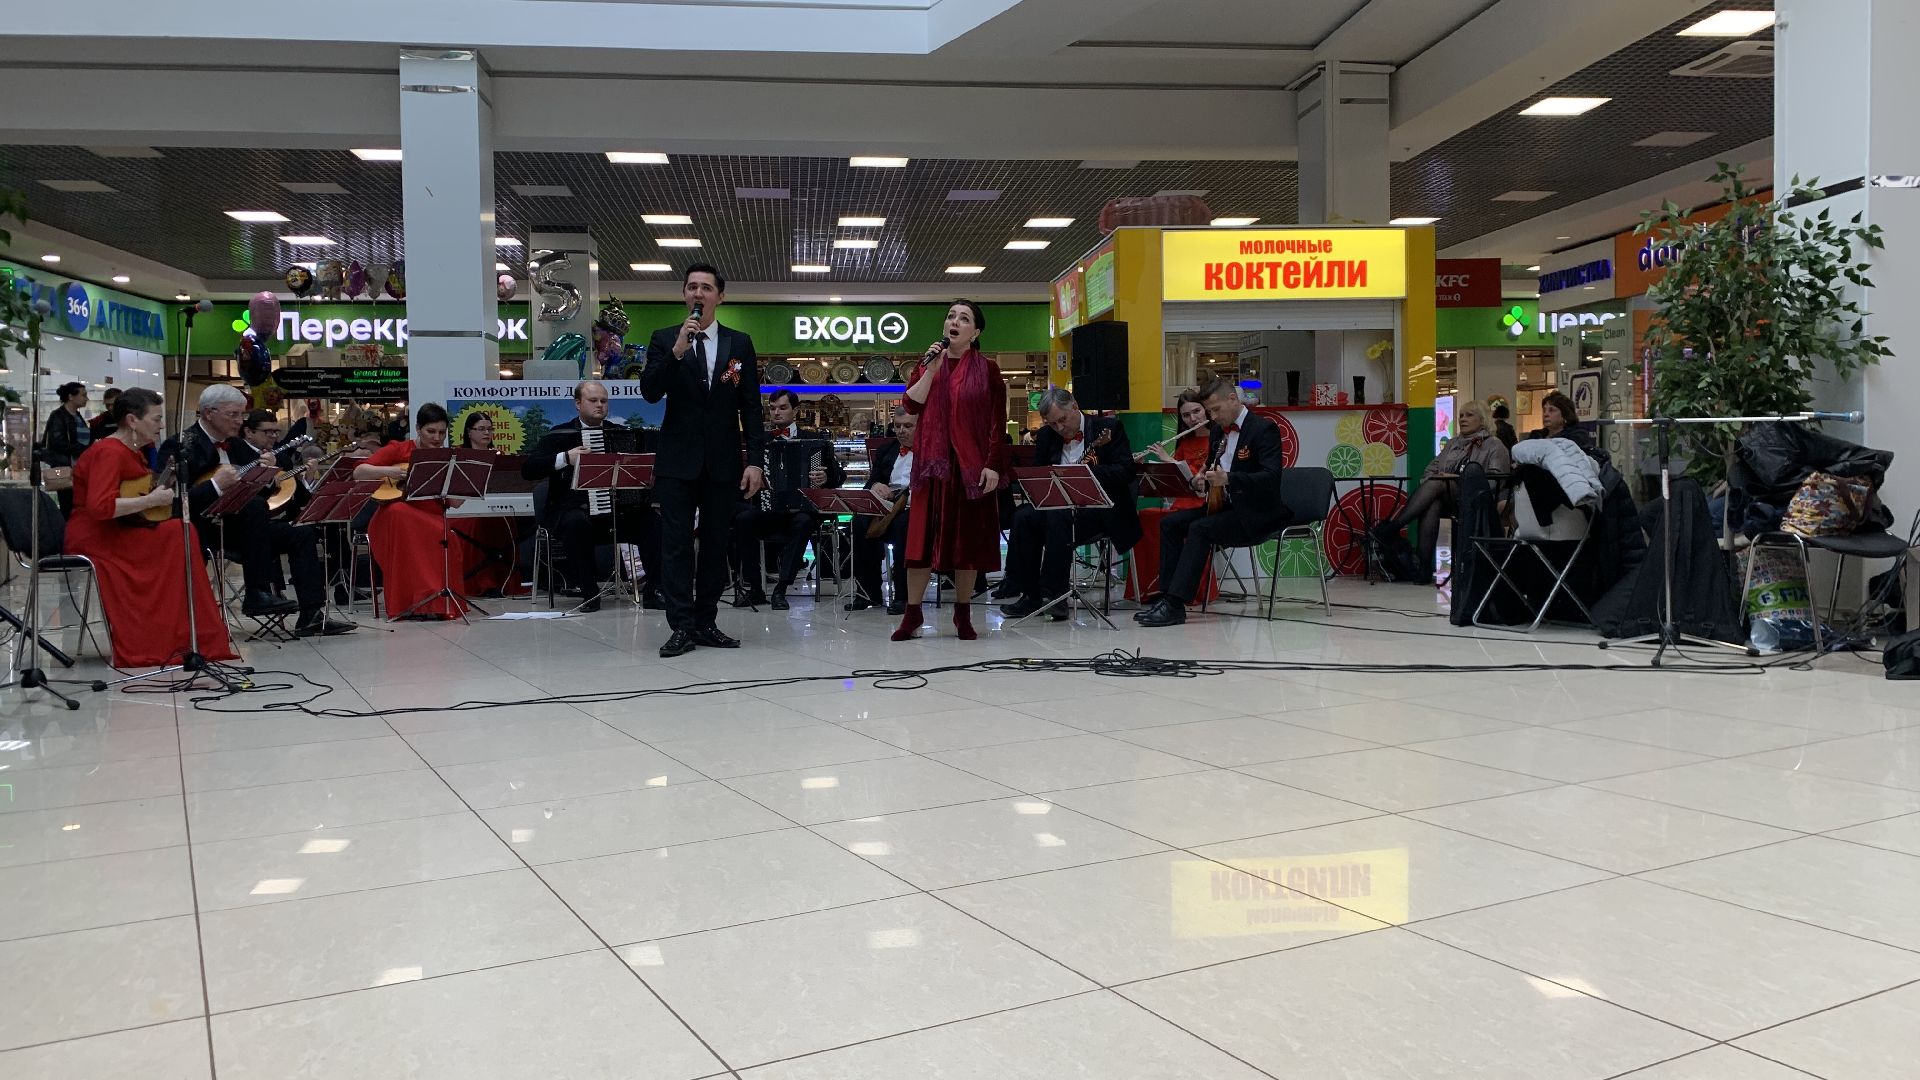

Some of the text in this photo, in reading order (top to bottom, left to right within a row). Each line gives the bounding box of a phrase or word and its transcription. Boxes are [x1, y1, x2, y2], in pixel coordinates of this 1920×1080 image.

[1435, 274, 1470, 287] KFC
[794, 316, 875, 344] ВХОД
[453, 386, 561, 399] КОМФОРТНЫЕ
